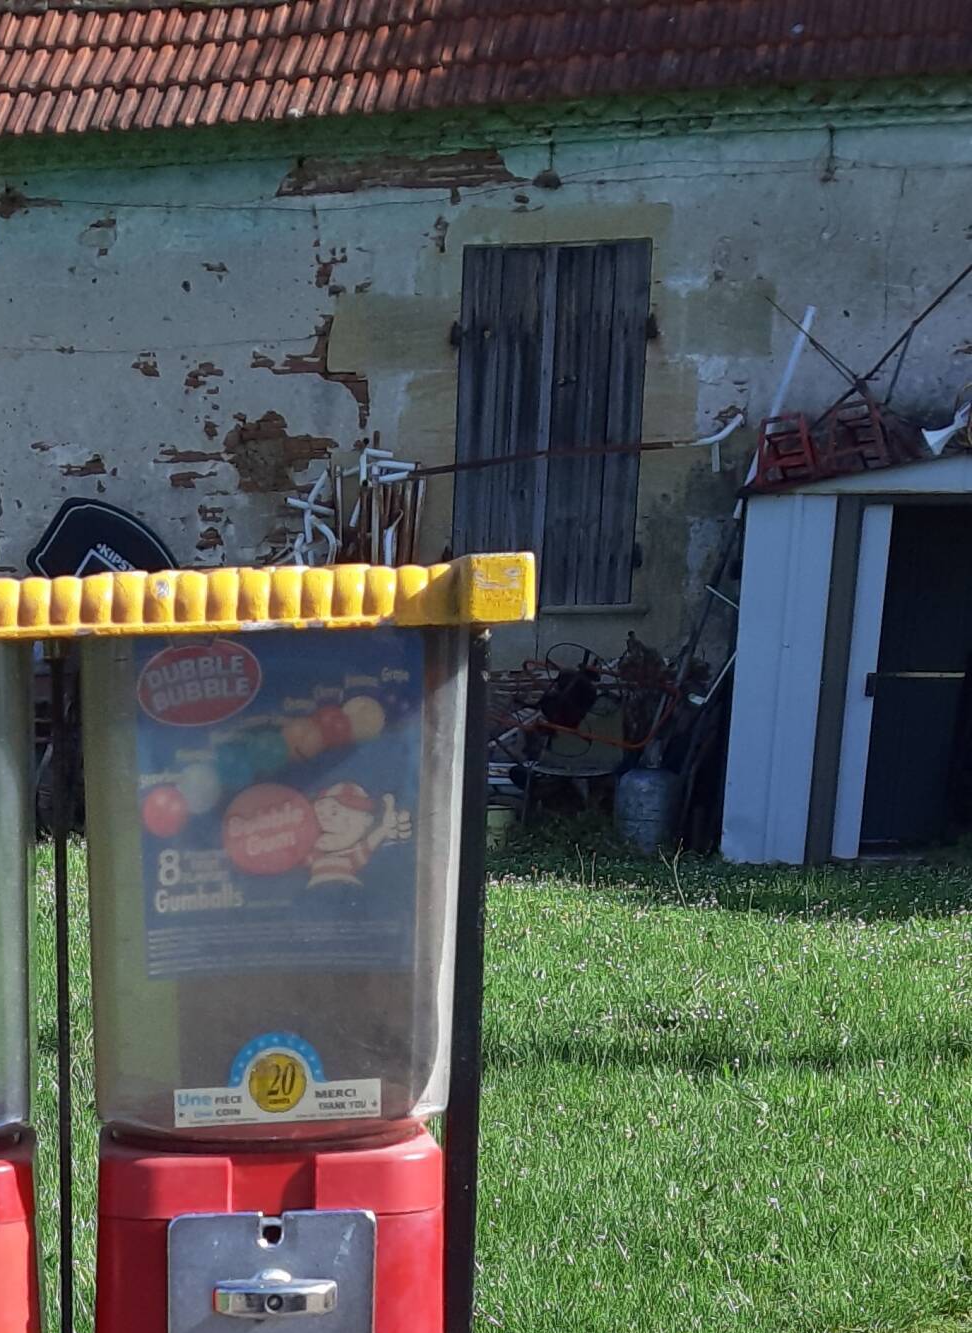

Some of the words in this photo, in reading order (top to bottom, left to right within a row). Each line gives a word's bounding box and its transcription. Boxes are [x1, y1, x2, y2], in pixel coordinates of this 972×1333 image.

[146, 655, 244, 689] DUBBLE
[152, 677, 249, 712] BUBBLE
[159, 849, 180, 886] 8
[155, 884, 244, 913] Gumballs
[267, 1062, 296, 1096] 20
[314, 1089, 357, 1099] MERCI
[177, 1094, 212, 1107] Une
[348, 1101, 367, 1110] YOU
